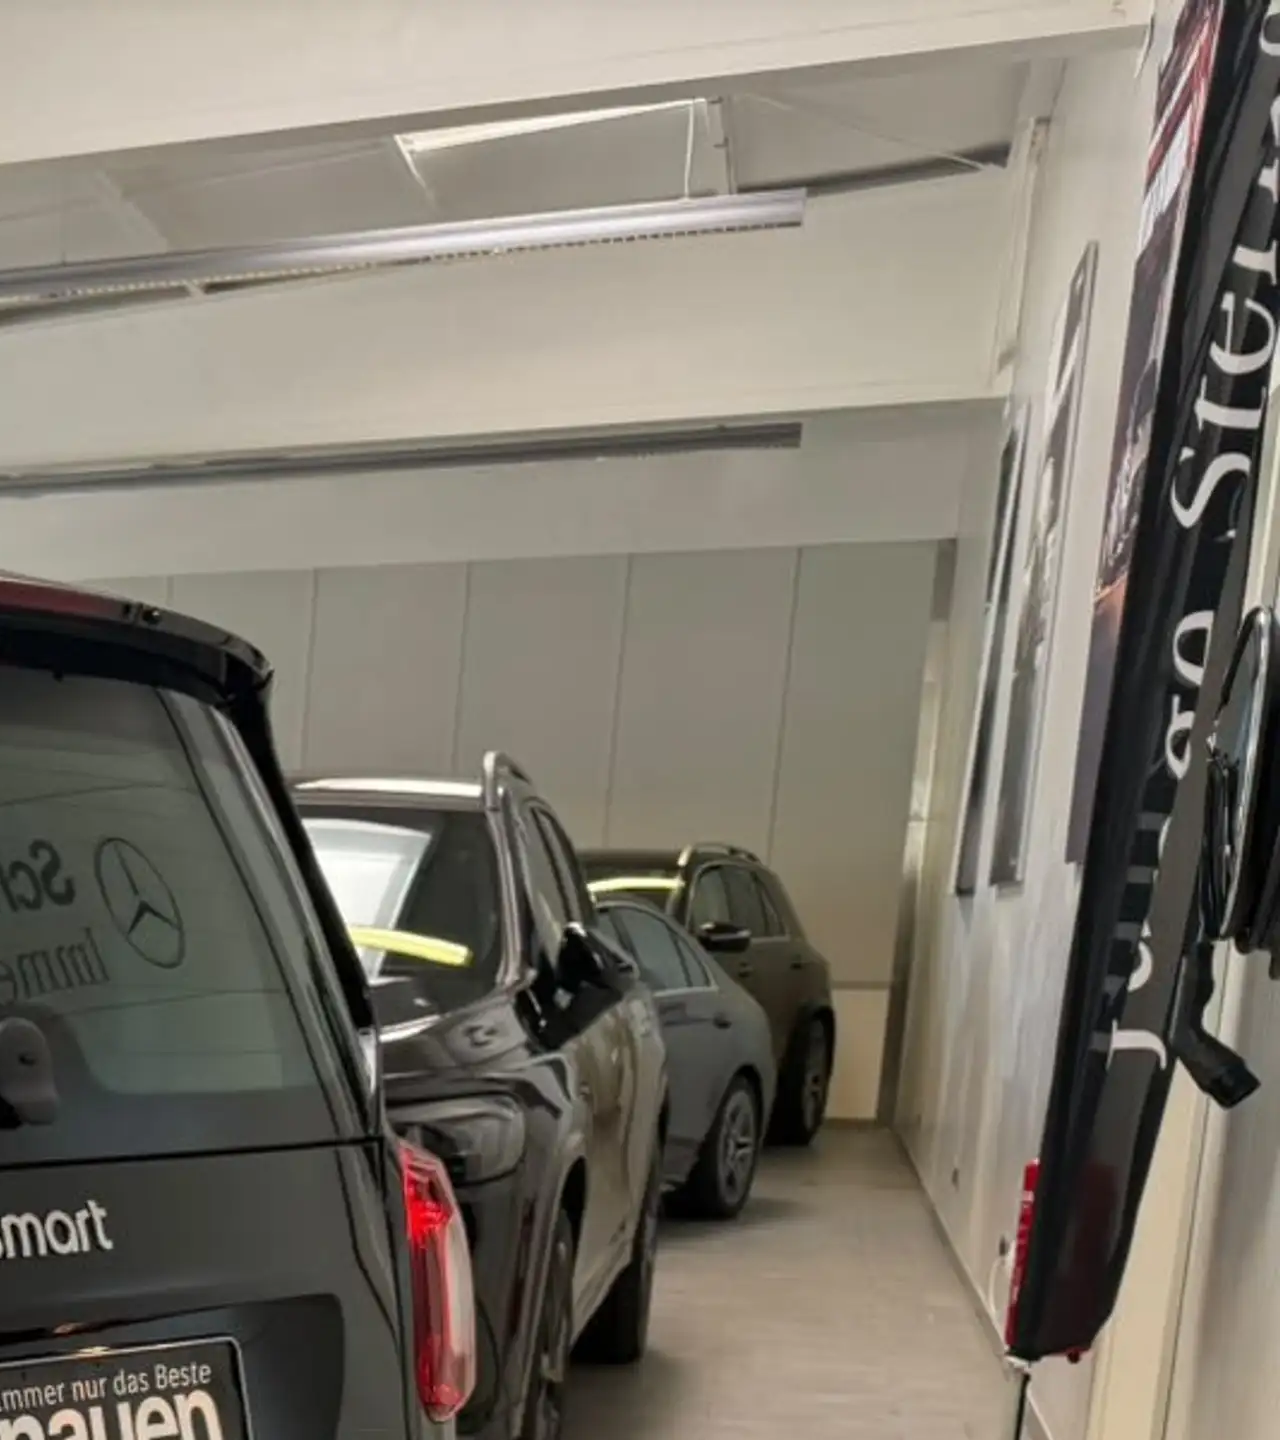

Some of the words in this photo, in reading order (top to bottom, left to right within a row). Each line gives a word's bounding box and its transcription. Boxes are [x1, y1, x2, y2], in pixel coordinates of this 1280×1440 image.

[1171, 0, 1280, 541] Ster
[71, 1375, 108, 1403] nur
[111, 1369, 149, 1397] das
[153, 1361, 212, 1388] Beste
